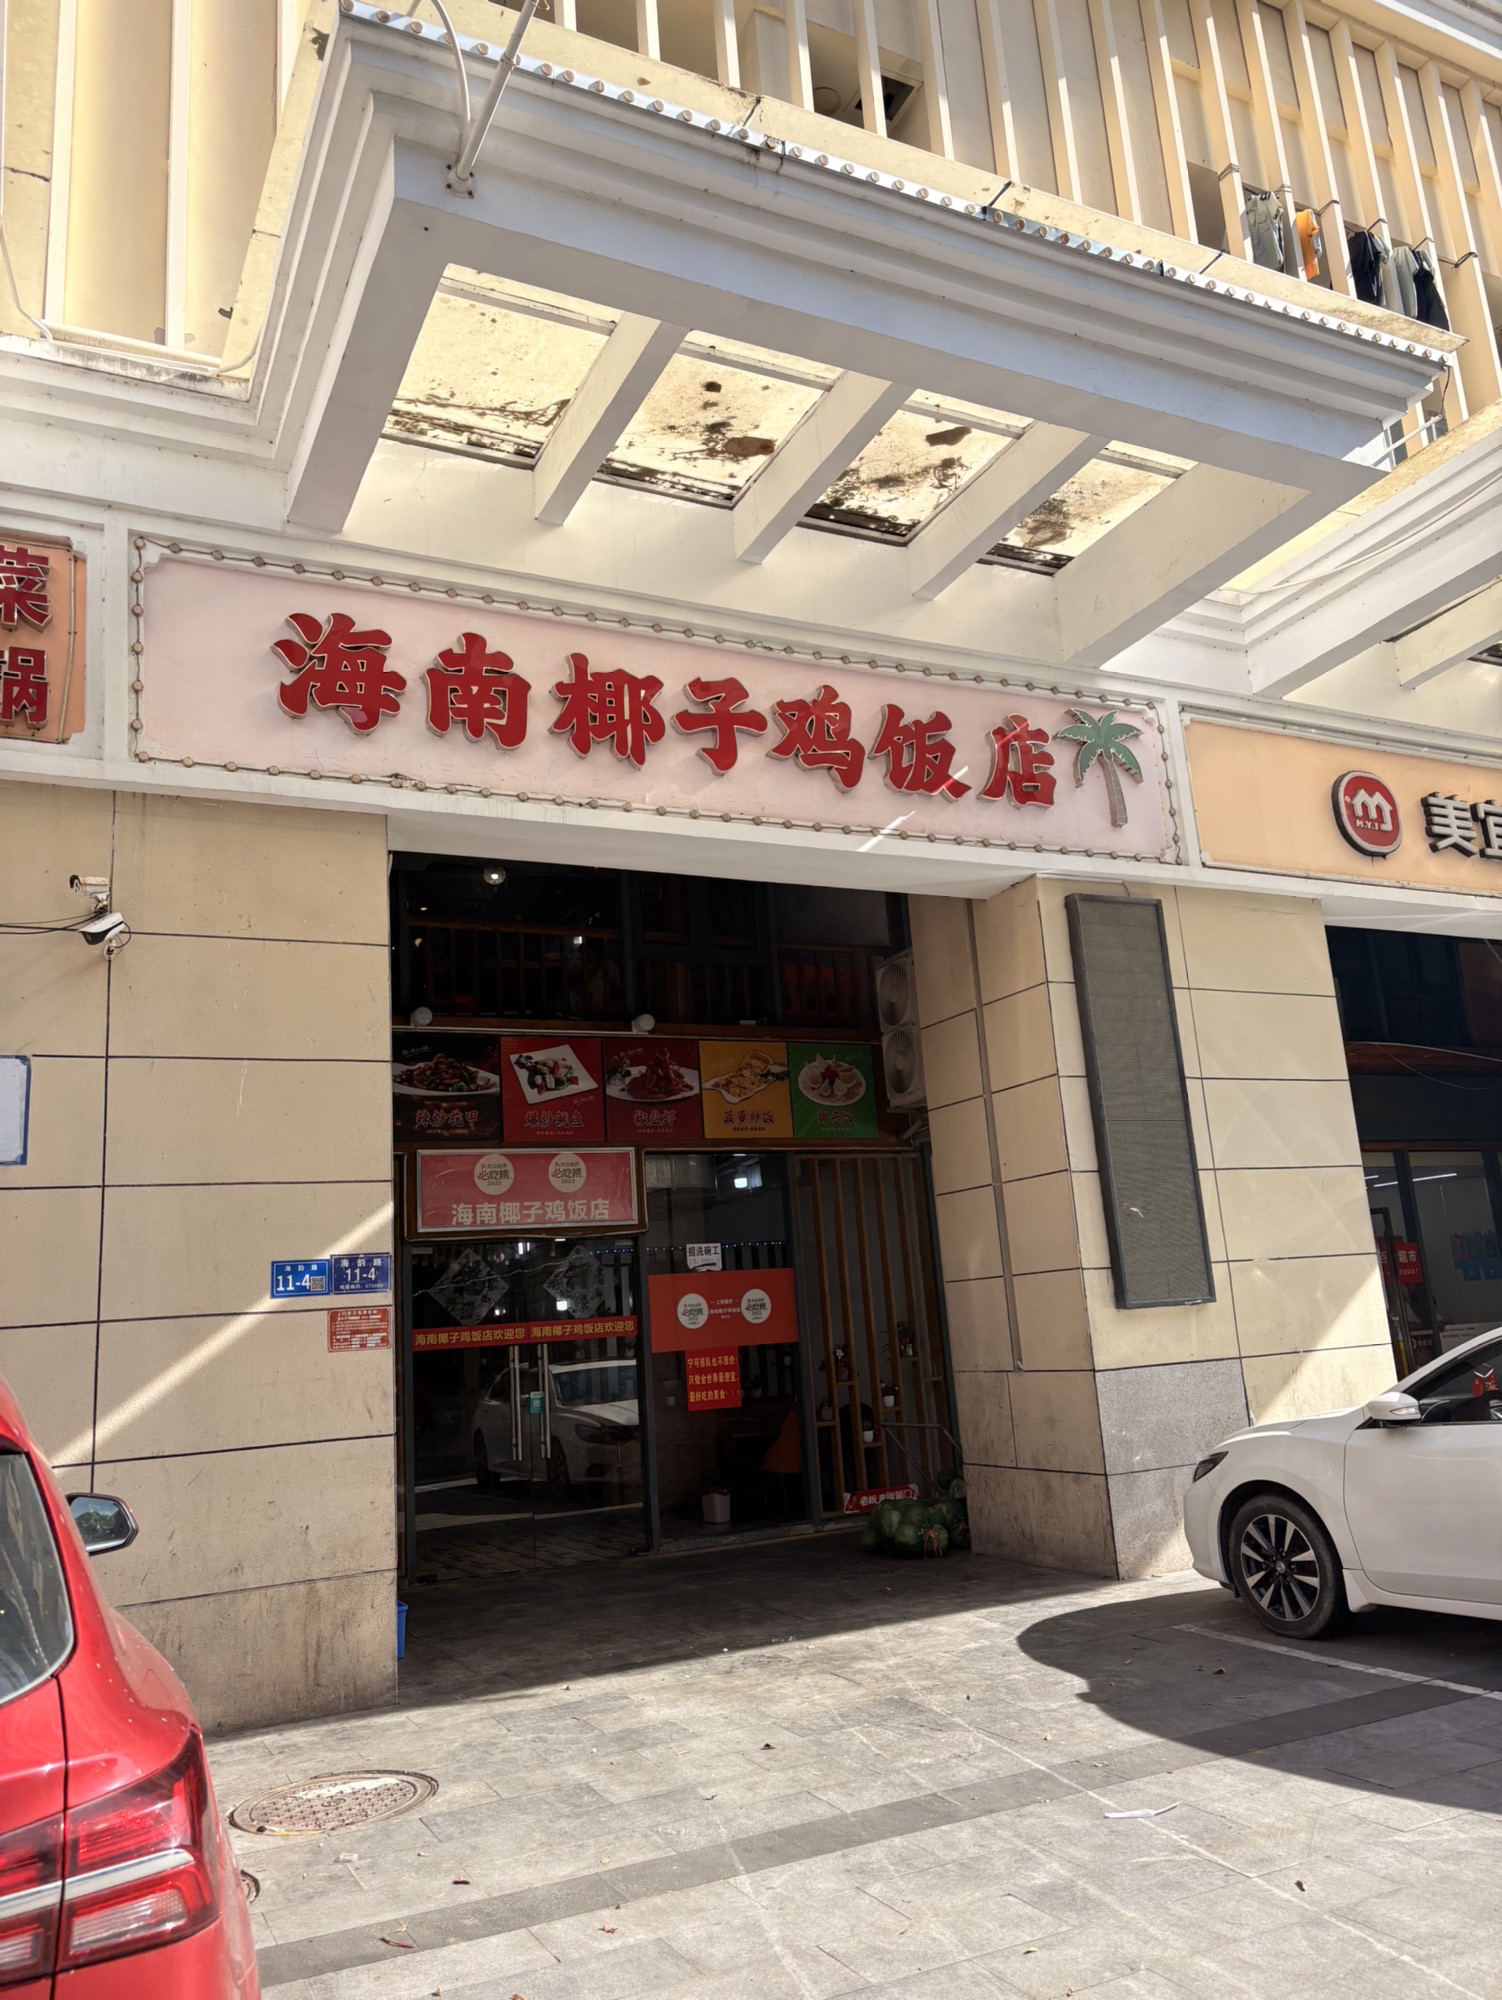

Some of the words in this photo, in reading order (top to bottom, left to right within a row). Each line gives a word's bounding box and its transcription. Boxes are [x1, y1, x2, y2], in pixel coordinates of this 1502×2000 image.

[270, 612, 1059, 810] 海南椰子鸡饭店
[415, 1108, 480, 1128] 辣炒花甲
[524, 1110, 585, 1128] 爆炒鱿鱼
[722, 1109, 775, 1125] 菠萝炒饭
[817, 1110, 855, 1126] 椰子饭
[452, 1199, 610, 1226] 海南椰子鸡饭店
[1397, 1249, 1418, 1263] 超市
[276, 1273, 311, 1291] 11-4
[345, 1267, 376, 1282] 11-4
[415, 1328, 525, 1346] 海南椰子鸡饭店欢迎您
[531, 1320, 635, 1338] 海南椰子鸡饭店欢迎您
